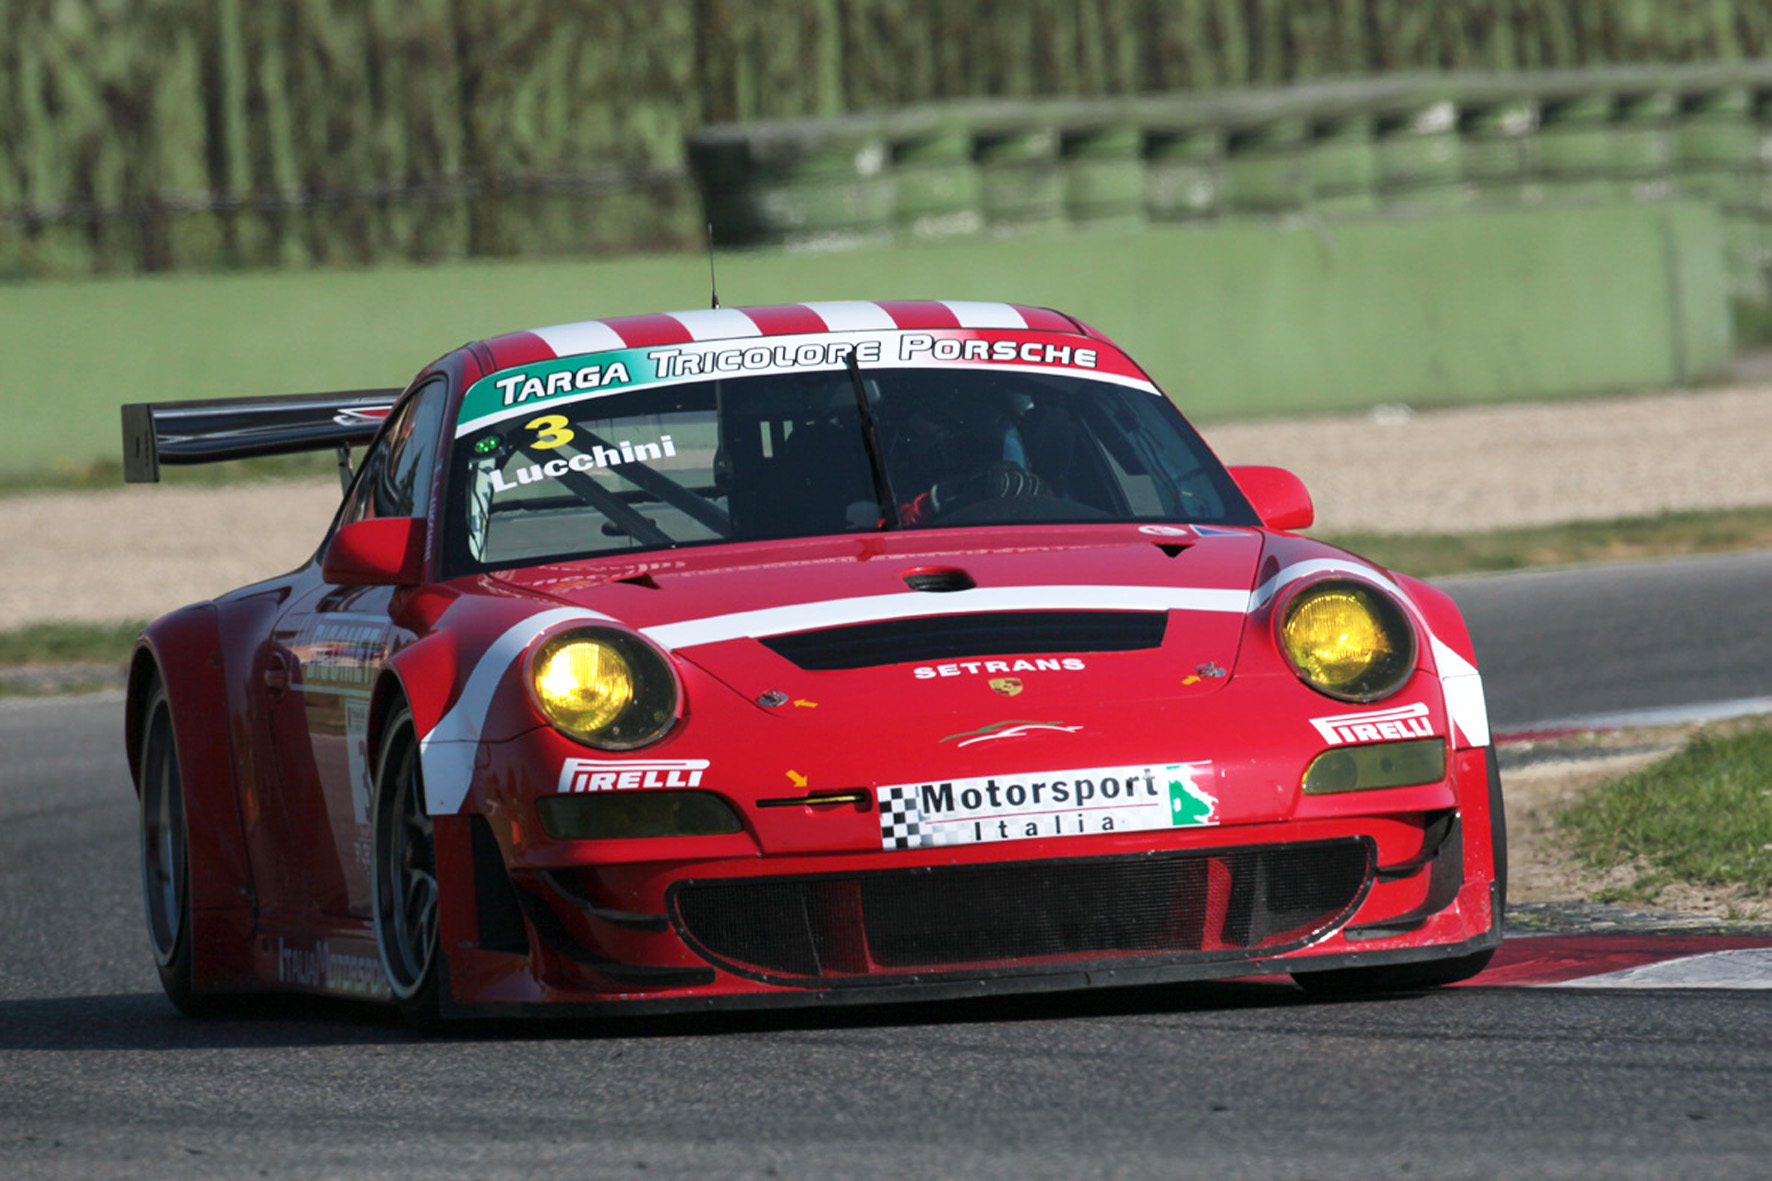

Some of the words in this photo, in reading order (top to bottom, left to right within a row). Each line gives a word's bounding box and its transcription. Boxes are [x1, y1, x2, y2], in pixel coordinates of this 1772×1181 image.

[495, 362, 631, 406] TARGA
[648, 341, 881, 379] TRICOLORE
[899, 334, 1098, 369] PORSCHE
[525, 414, 575, 450] 3
[489, 435, 676, 493] Lucchini
[913, 658, 1085, 679] SETRANS
[1308, 702, 1434, 745] PIRELLI
[557, 757, 711, 793] PIRELLI
[920, 768, 1159, 815] Motorsport
[974, 814, 1115, 842] Italia
